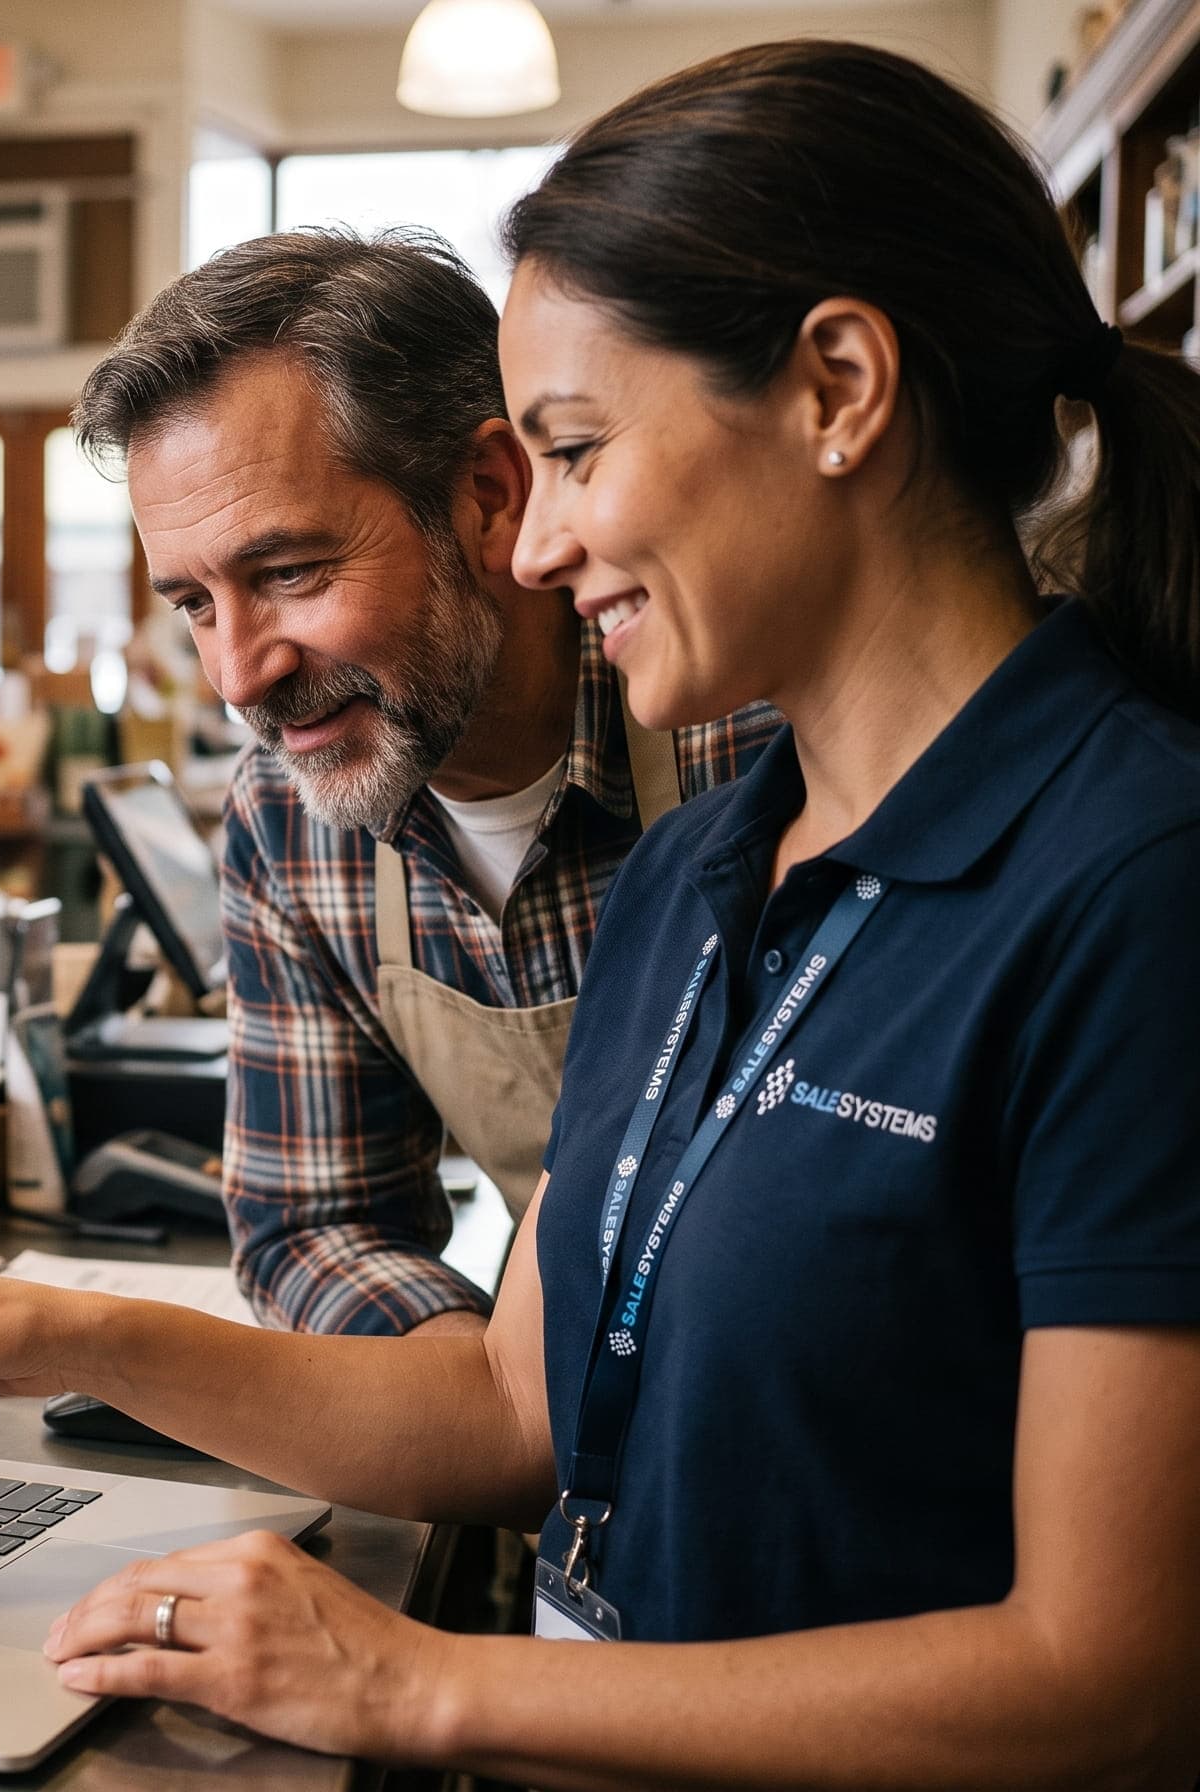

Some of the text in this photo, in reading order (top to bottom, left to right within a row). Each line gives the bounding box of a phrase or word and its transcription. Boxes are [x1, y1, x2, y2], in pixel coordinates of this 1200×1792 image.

[731, 953, 828, 1094] SALESYSTEMS
[790, 1081, 938, 1143] SALESYSTEMS
[621, 1180, 685, 1327] SALESYSTEMS
